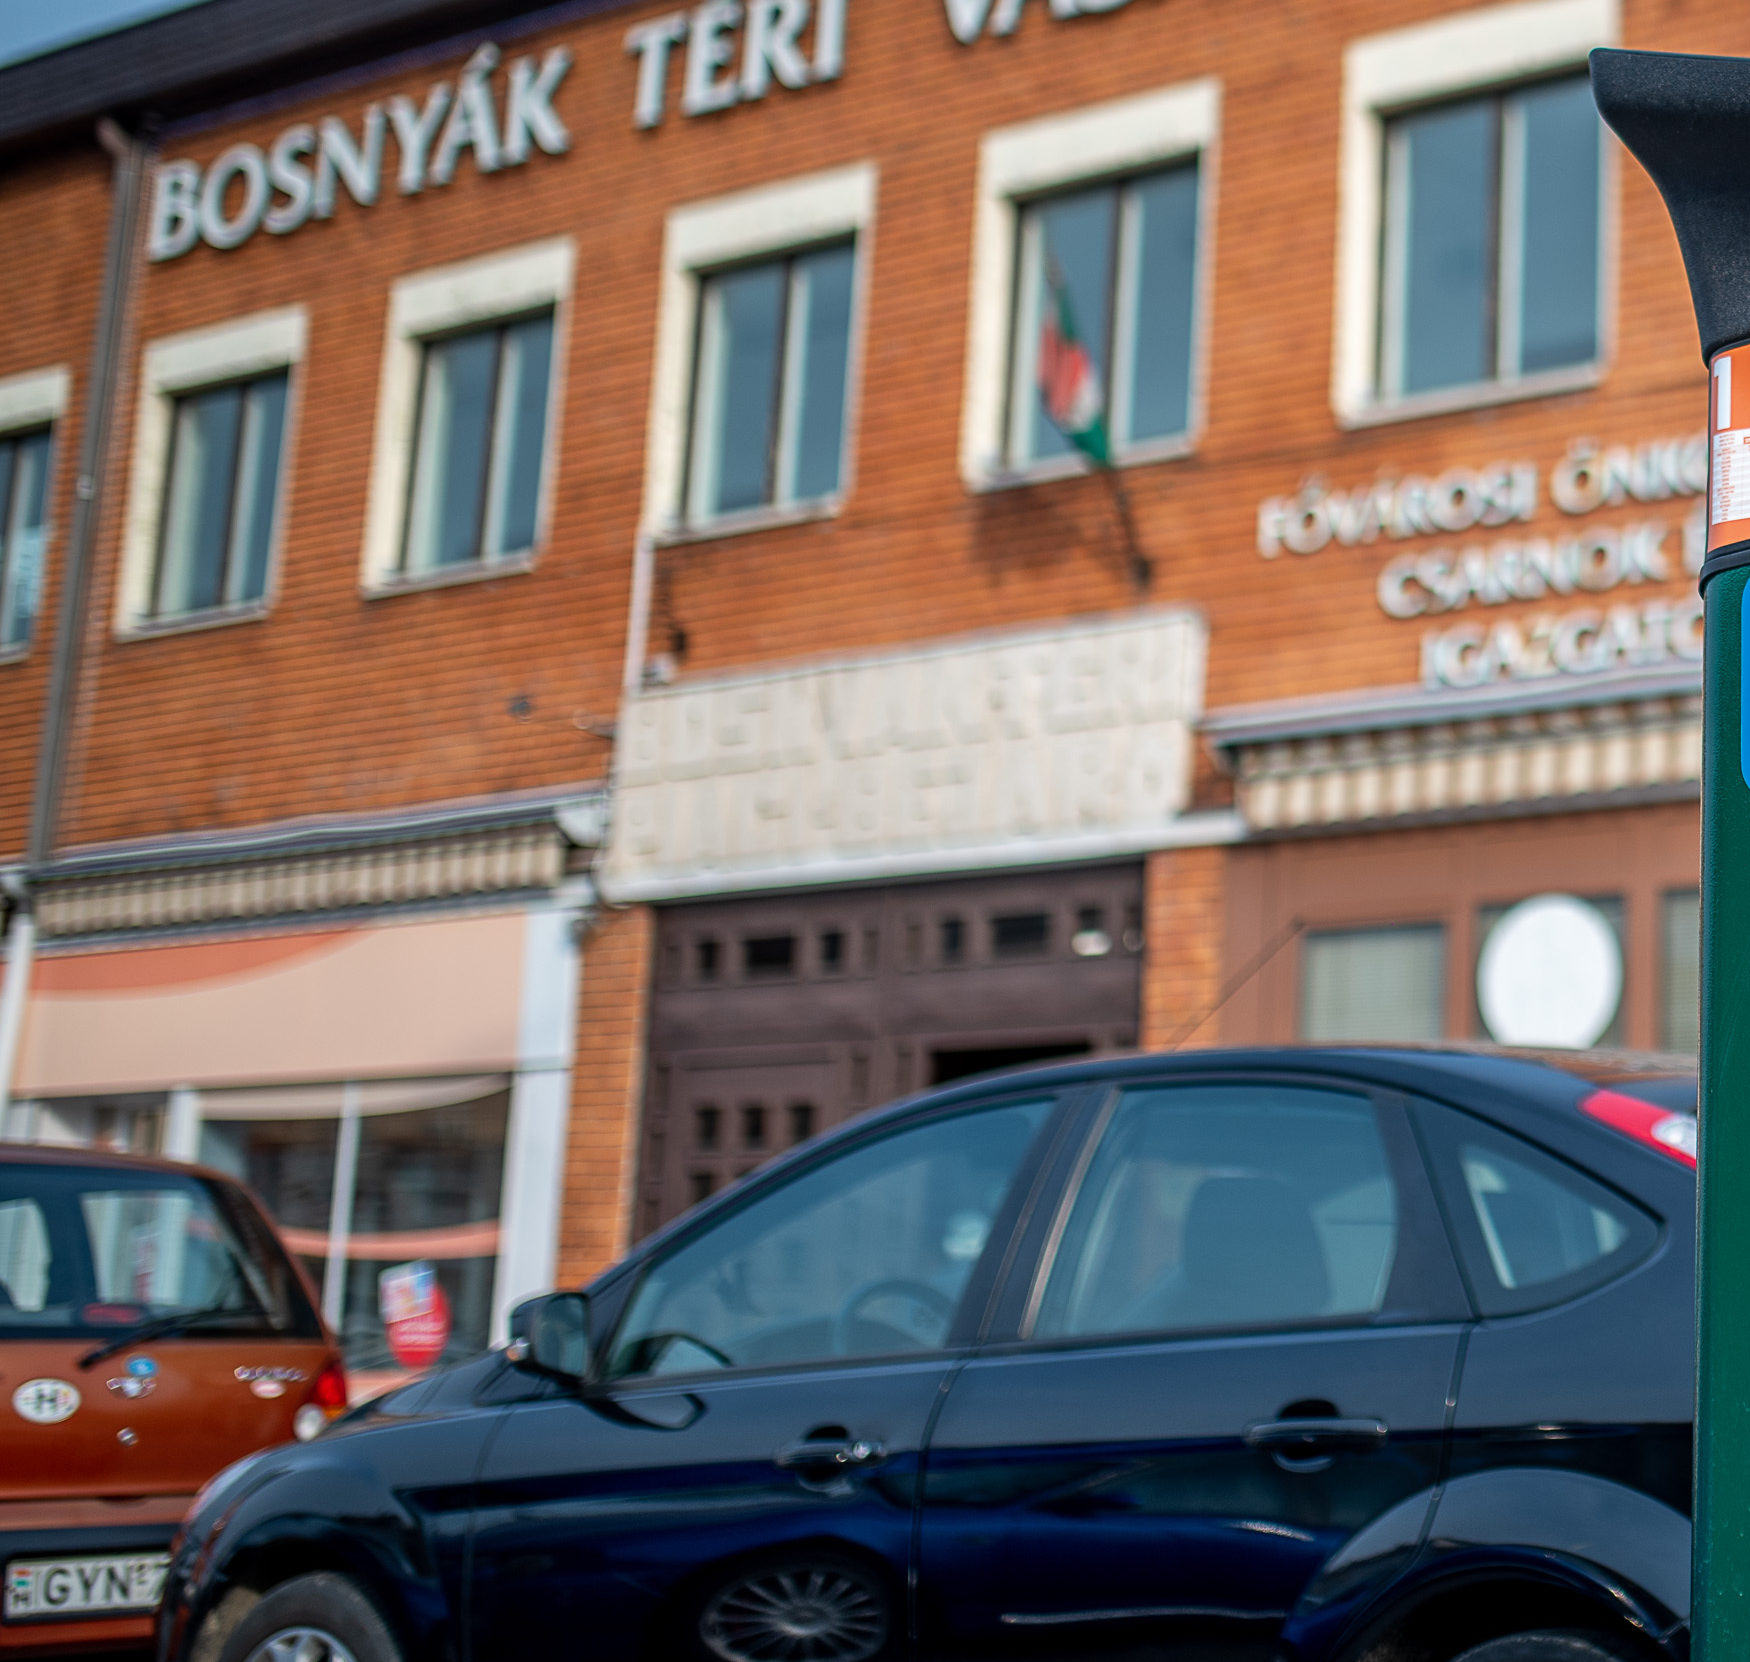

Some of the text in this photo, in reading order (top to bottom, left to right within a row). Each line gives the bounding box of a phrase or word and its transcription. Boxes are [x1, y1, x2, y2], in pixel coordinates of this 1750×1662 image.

[148, 42, 572, 263] BOSNYÁK
[1258, 461, 1537, 559] FŐVÁROSI
[1378, 519, 1668, 618] CSARNOK
